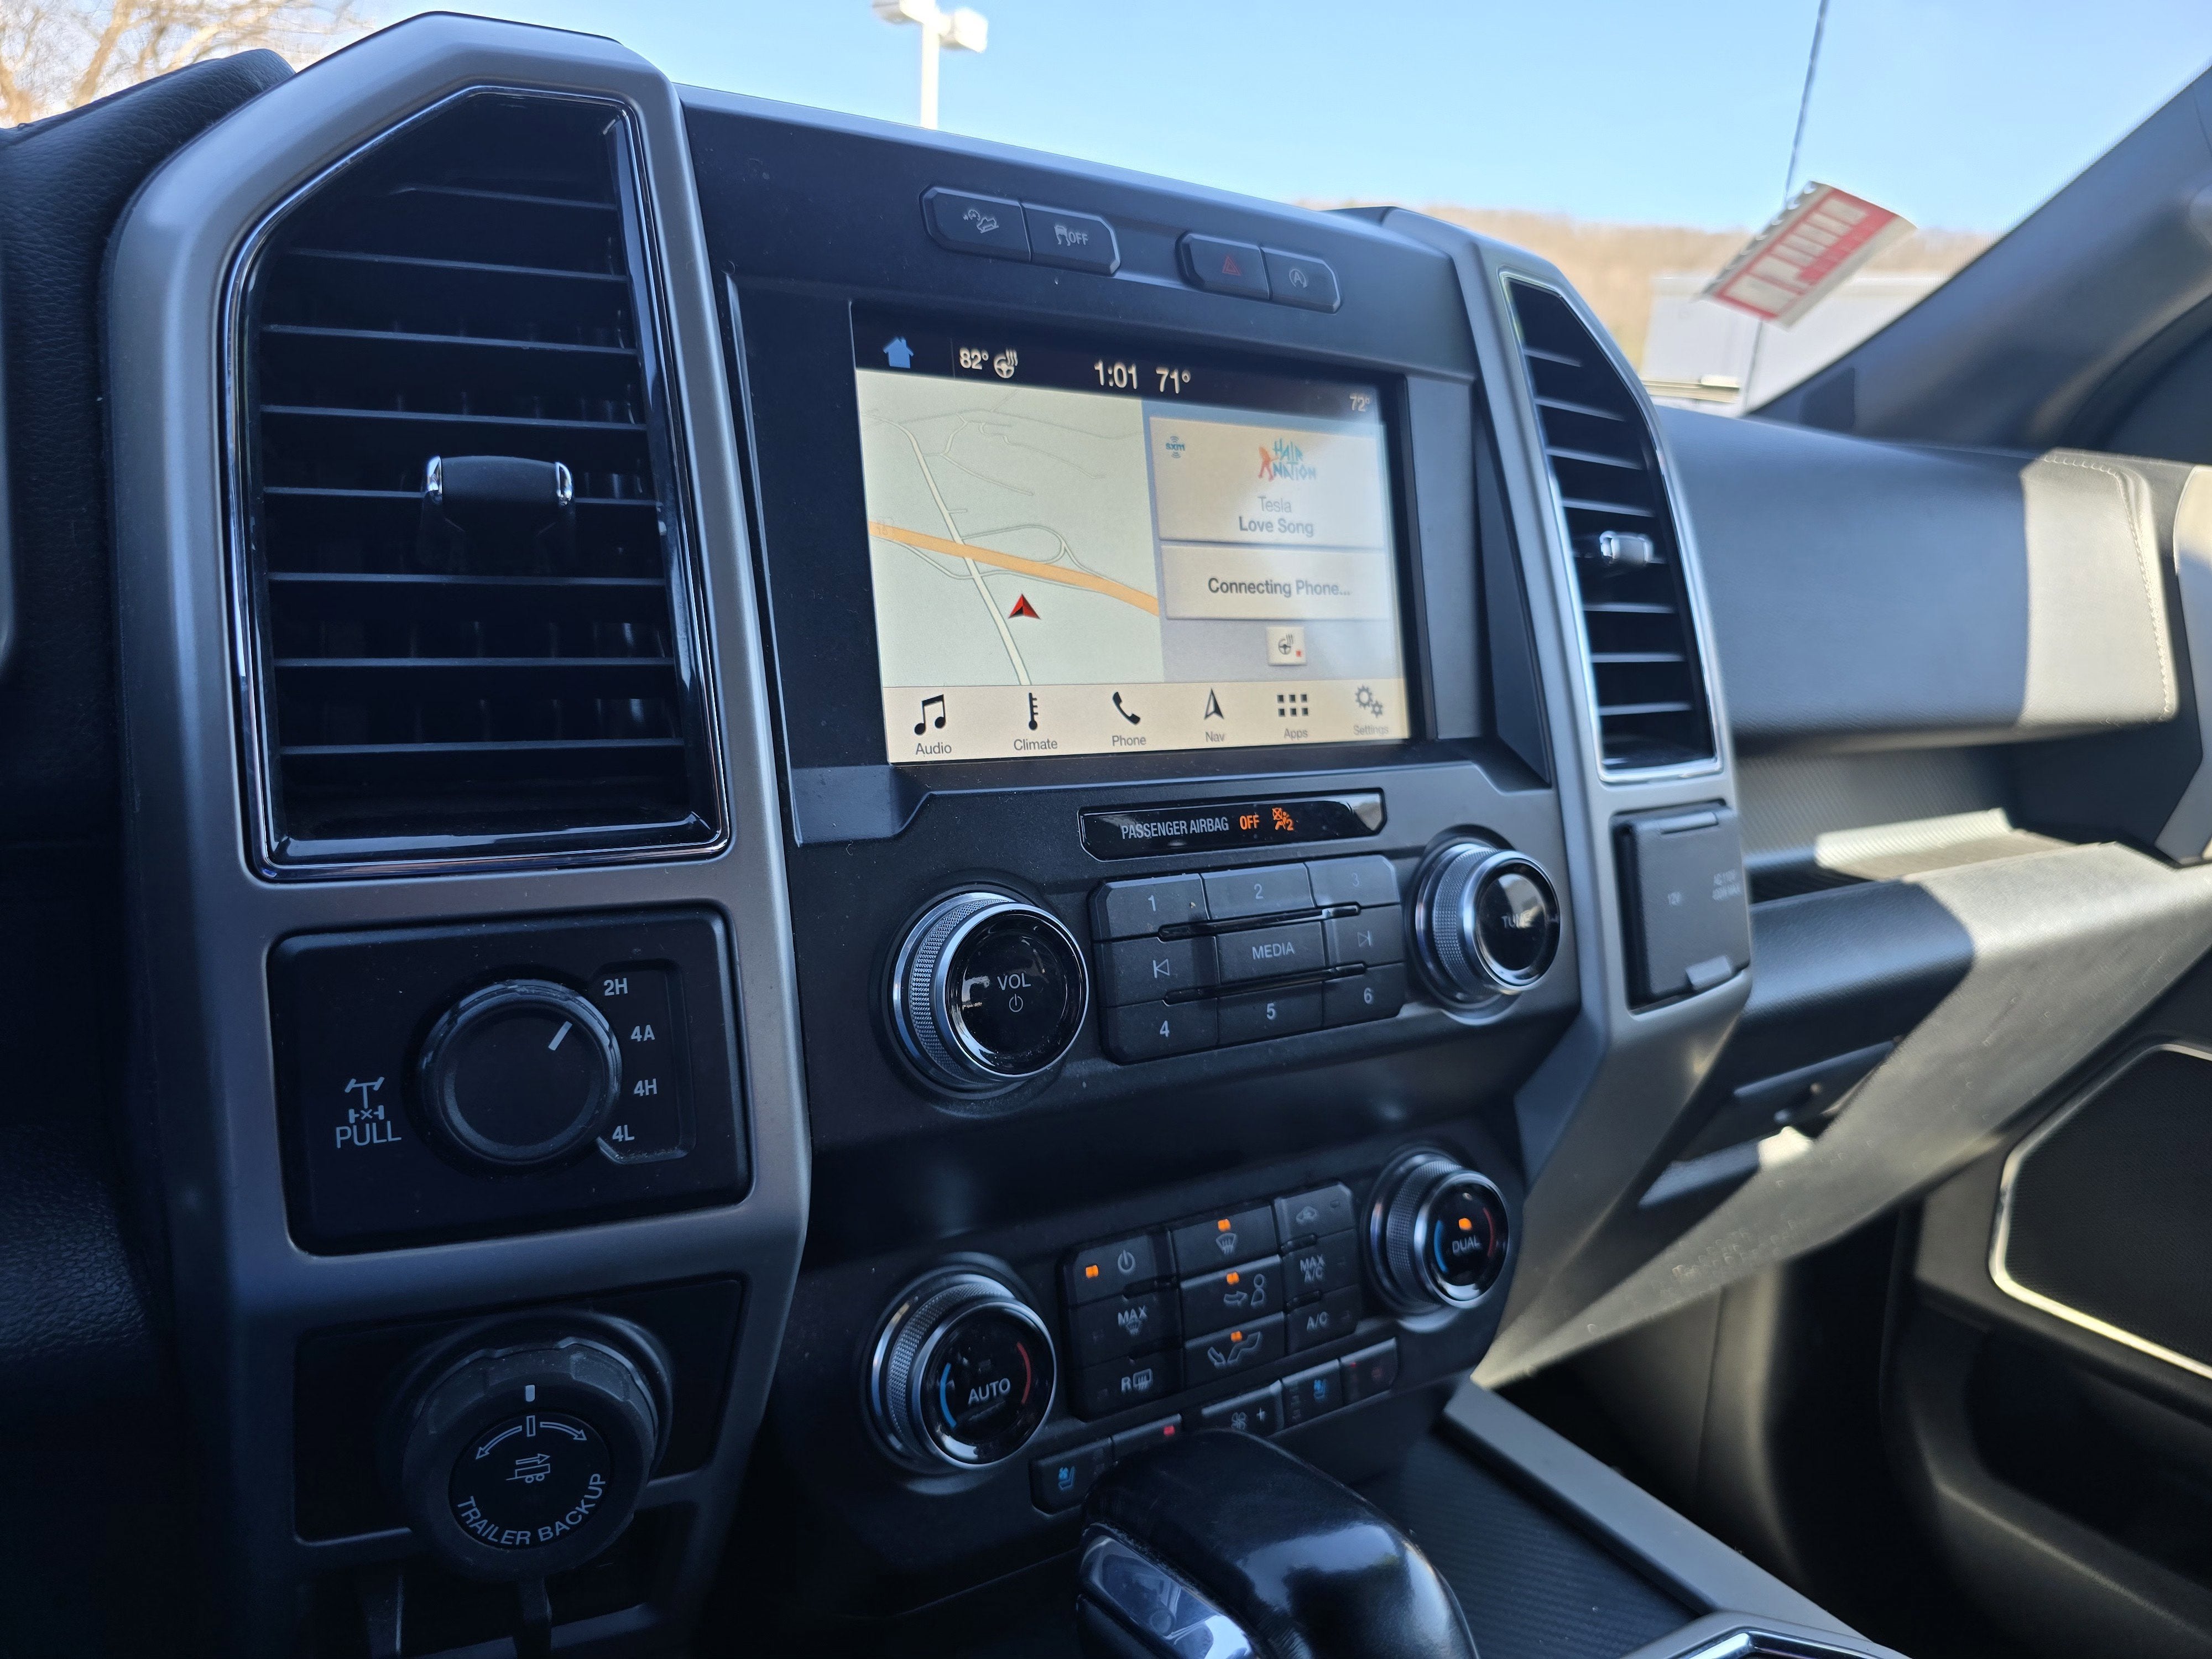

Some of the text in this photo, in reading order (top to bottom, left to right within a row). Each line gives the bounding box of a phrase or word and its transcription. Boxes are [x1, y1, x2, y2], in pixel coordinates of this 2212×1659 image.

[1068, 232, 1089, 246] OFF
[1094, 360, 1138, 389] 1:01
[1165, 441, 1185, 452] sxm
[1272, 437, 1304, 462] HAIR
[1272, 461, 1317, 481] NATION
[1258, 495, 1292, 513] Tesla
[1239, 516, 1314, 538] Love Song
[1208, 577, 1292, 598] Connecting
[1205, 731, 1225, 743] Nav
[1284, 727, 1308, 739] Apps
[1353, 723, 1389, 737] Settings
[915, 742, 952, 755] Audio
[1013, 738, 1058, 752] Climate
[1112, 734, 1146, 747] Phone
[1121, 815, 1260, 839] PASSENGER AIRBAG OFF
[1352, 873, 1360, 886] 3
[1254, 884, 1264, 899] 2
[1147, 895, 1156, 911] 1
[1252, 942, 1295, 959] MEDIA
[603, 978, 629, 996] 2H
[997, 973, 1031, 990] VOL
[1363, 987, 1373, 1003] 6
[1266, 1003, 1277, 1019] 5
[630, 1025, 655, 1042] 4A
[1159, 1020, 1170, 1037] 4
[634, 1078, 658, 1096] 4H
[335, 1121, 402, 1149] PULL
[612, 1125, 635, 1142] 4L
[1452, 1235, 1480, 1255] DUAL
[1300, 1254, 1326, 1271] MAX
[1304, 1267, 1324, 1283] A/C
[1118, 1306, 1148, 1325] MAX
[1307, 1312, 1330, 1331] A/C
[968, 1378, 1010, 1406] AUTO
[1121, 1376, 1132, 1392] R
[457, 1473, 606, 1546] TRAILER BACKUP
